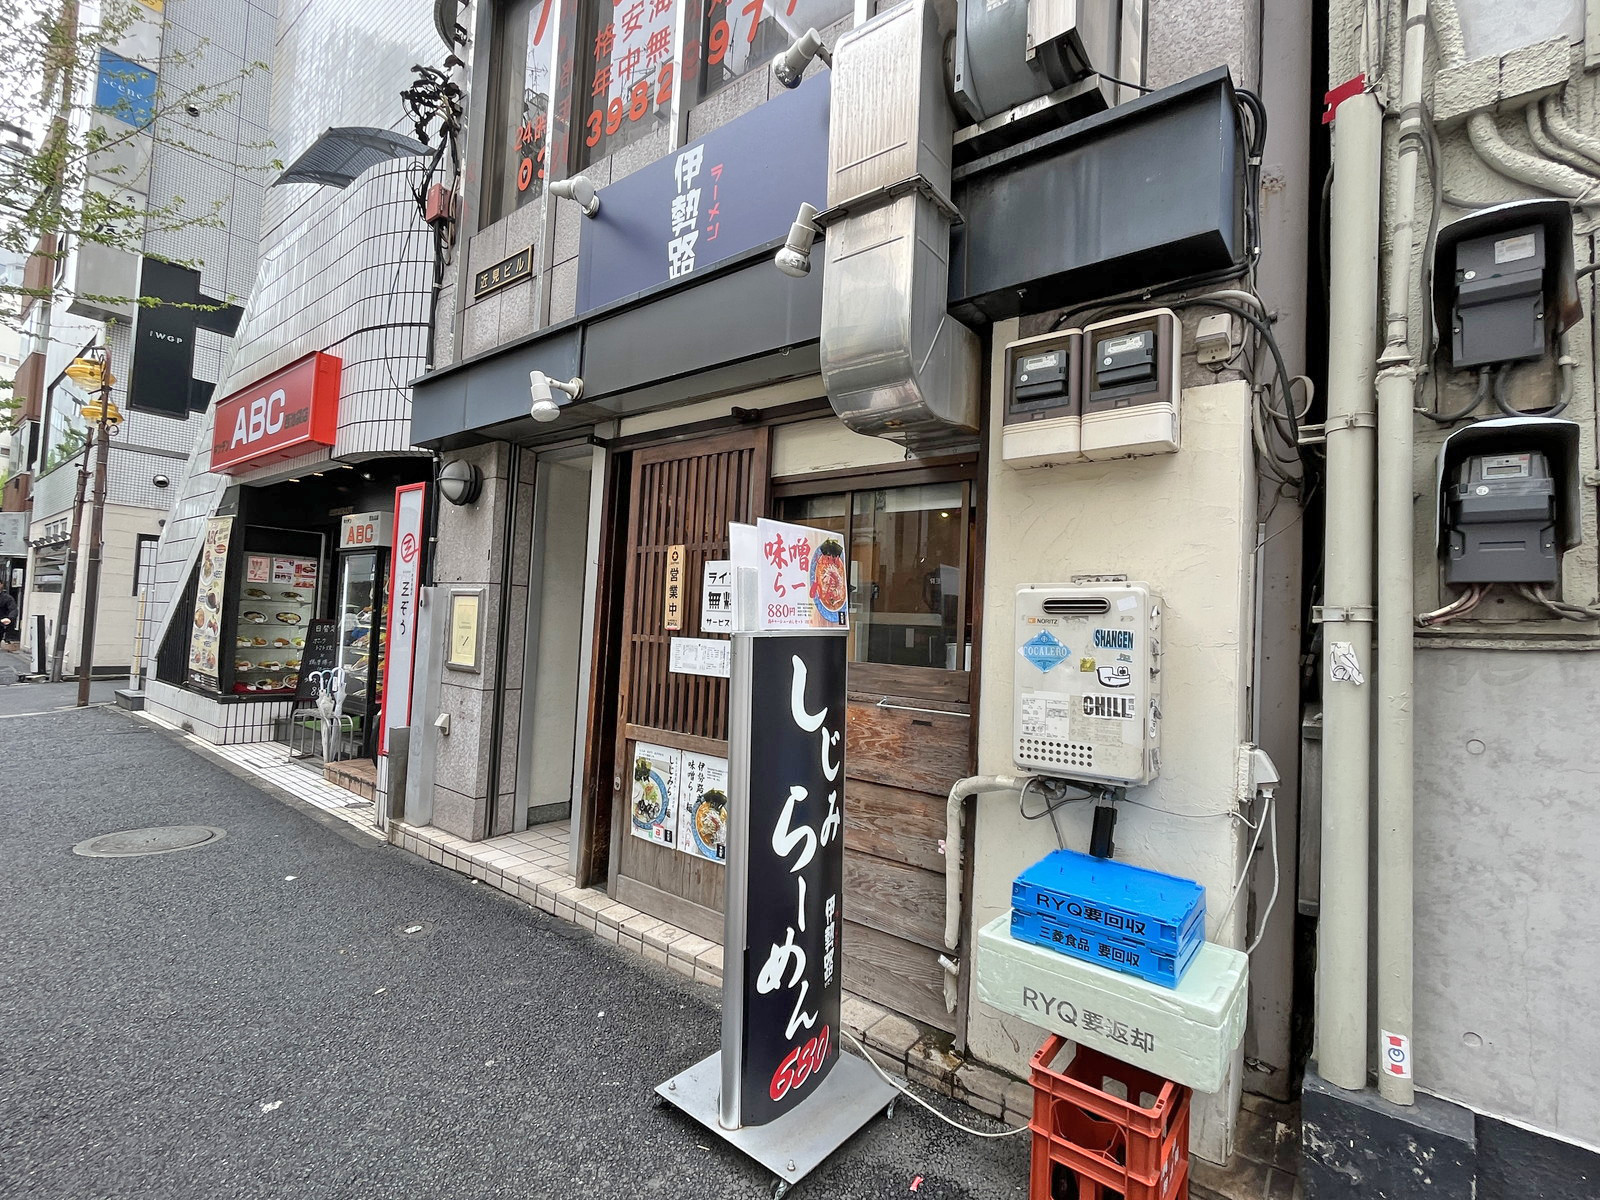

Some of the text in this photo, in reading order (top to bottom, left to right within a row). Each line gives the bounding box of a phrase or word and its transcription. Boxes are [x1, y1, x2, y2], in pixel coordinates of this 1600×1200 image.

[668, 143, 705, 280] 伊勢路
[706, 163, 723, 242] ラーメン
[149, 330, 183, 344] IWGP
[230, 388, 286, 450] ABC
[346, 523, 374, 545] ABC
[763, 532, 812, 573] 味噌
[668, 567, 680, 617] 営業中
[708, 571, 732, 585] ライ
[1023, 646, 1068, 657] COCALERO
[1095, 629, 1134, 648] SHANGEN
[1082, 695, 1127, 718] CHILL
[1039, 925, 1141, 968] 三菱食品 要回収
